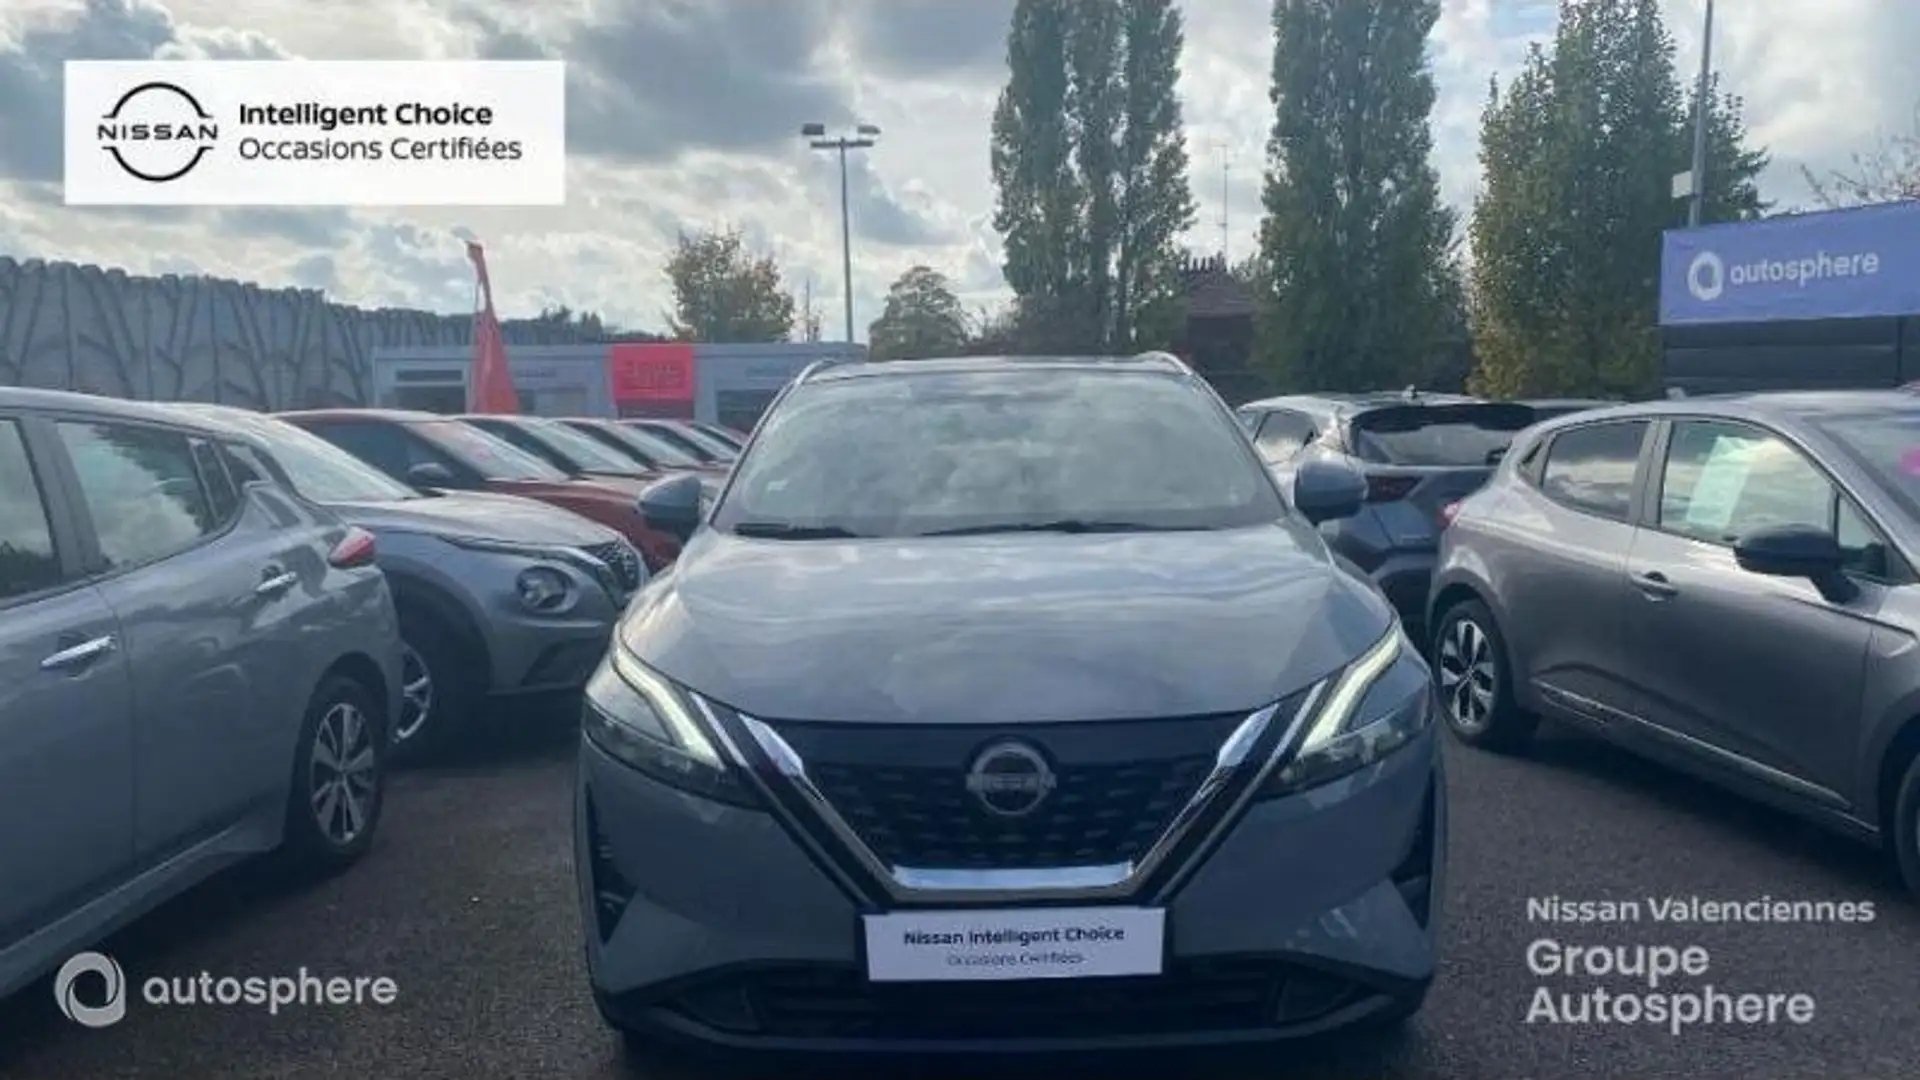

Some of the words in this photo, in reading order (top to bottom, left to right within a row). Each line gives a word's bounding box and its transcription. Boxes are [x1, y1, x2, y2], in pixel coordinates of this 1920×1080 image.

[1730, 251, 1880, 288] autosphere
[903, 929, 963, 946] Nissan
[969, 926, 1060, 946] Intelligent
[1066, 924, 1125, 942] Choice
